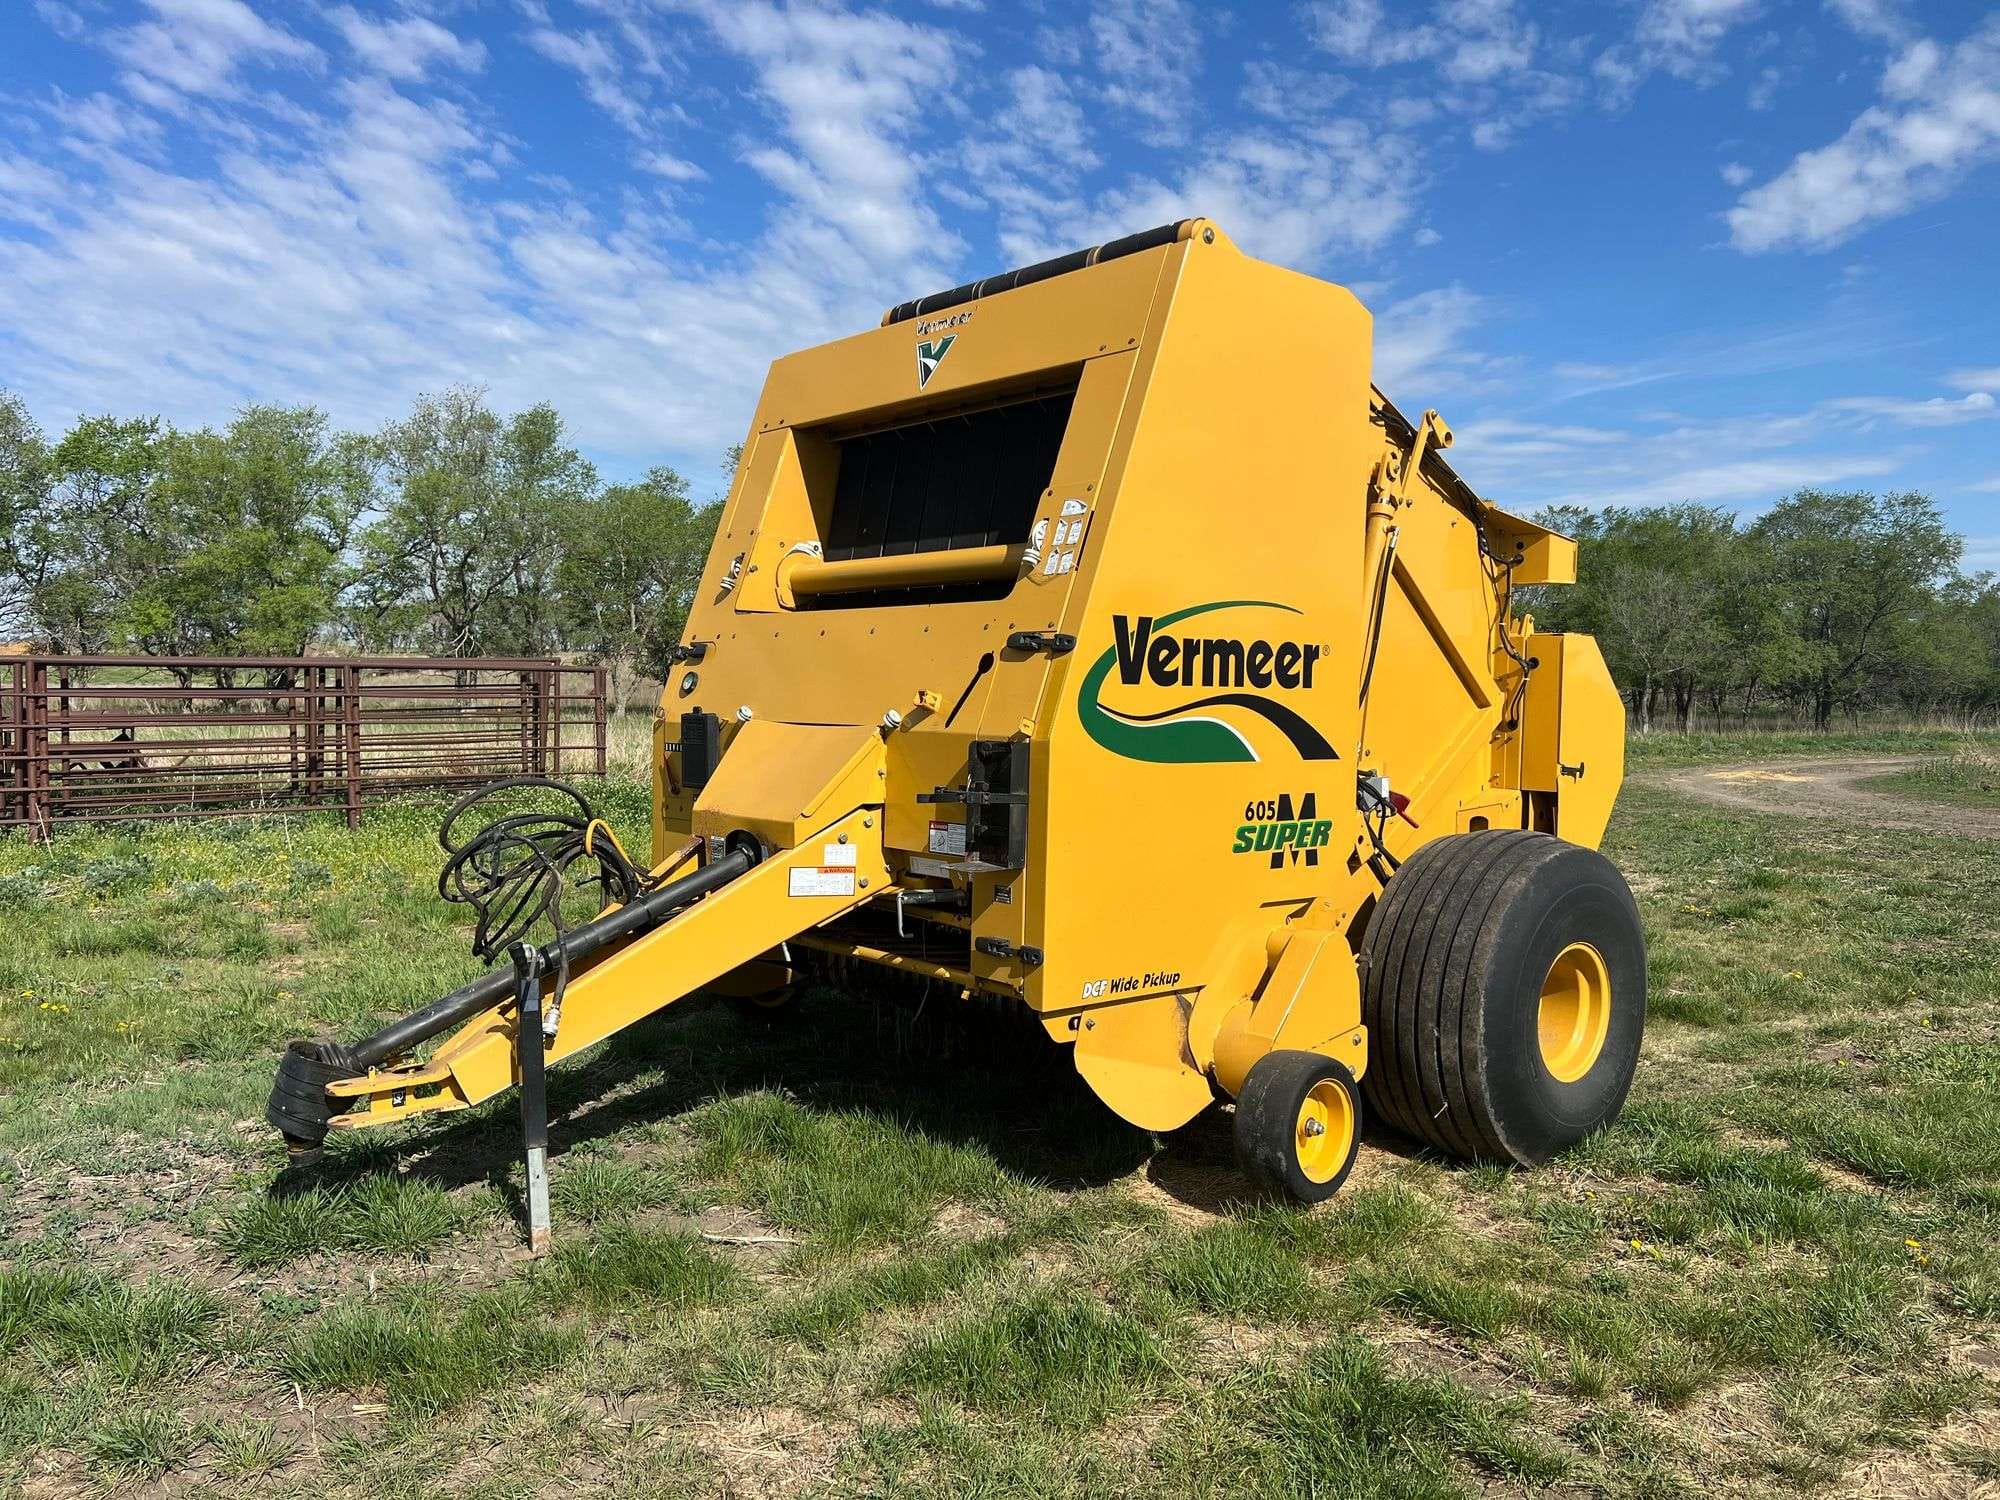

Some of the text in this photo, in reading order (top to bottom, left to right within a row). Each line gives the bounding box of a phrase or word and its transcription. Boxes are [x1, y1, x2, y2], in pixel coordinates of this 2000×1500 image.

[1112, 614, 1320, 689] Vermeer
[1244, 800, 1276, 821] 605
[1231, 820, 1333, 854] SUPER
[1081, 971, 1181, 999] DCF Wide Pickup
